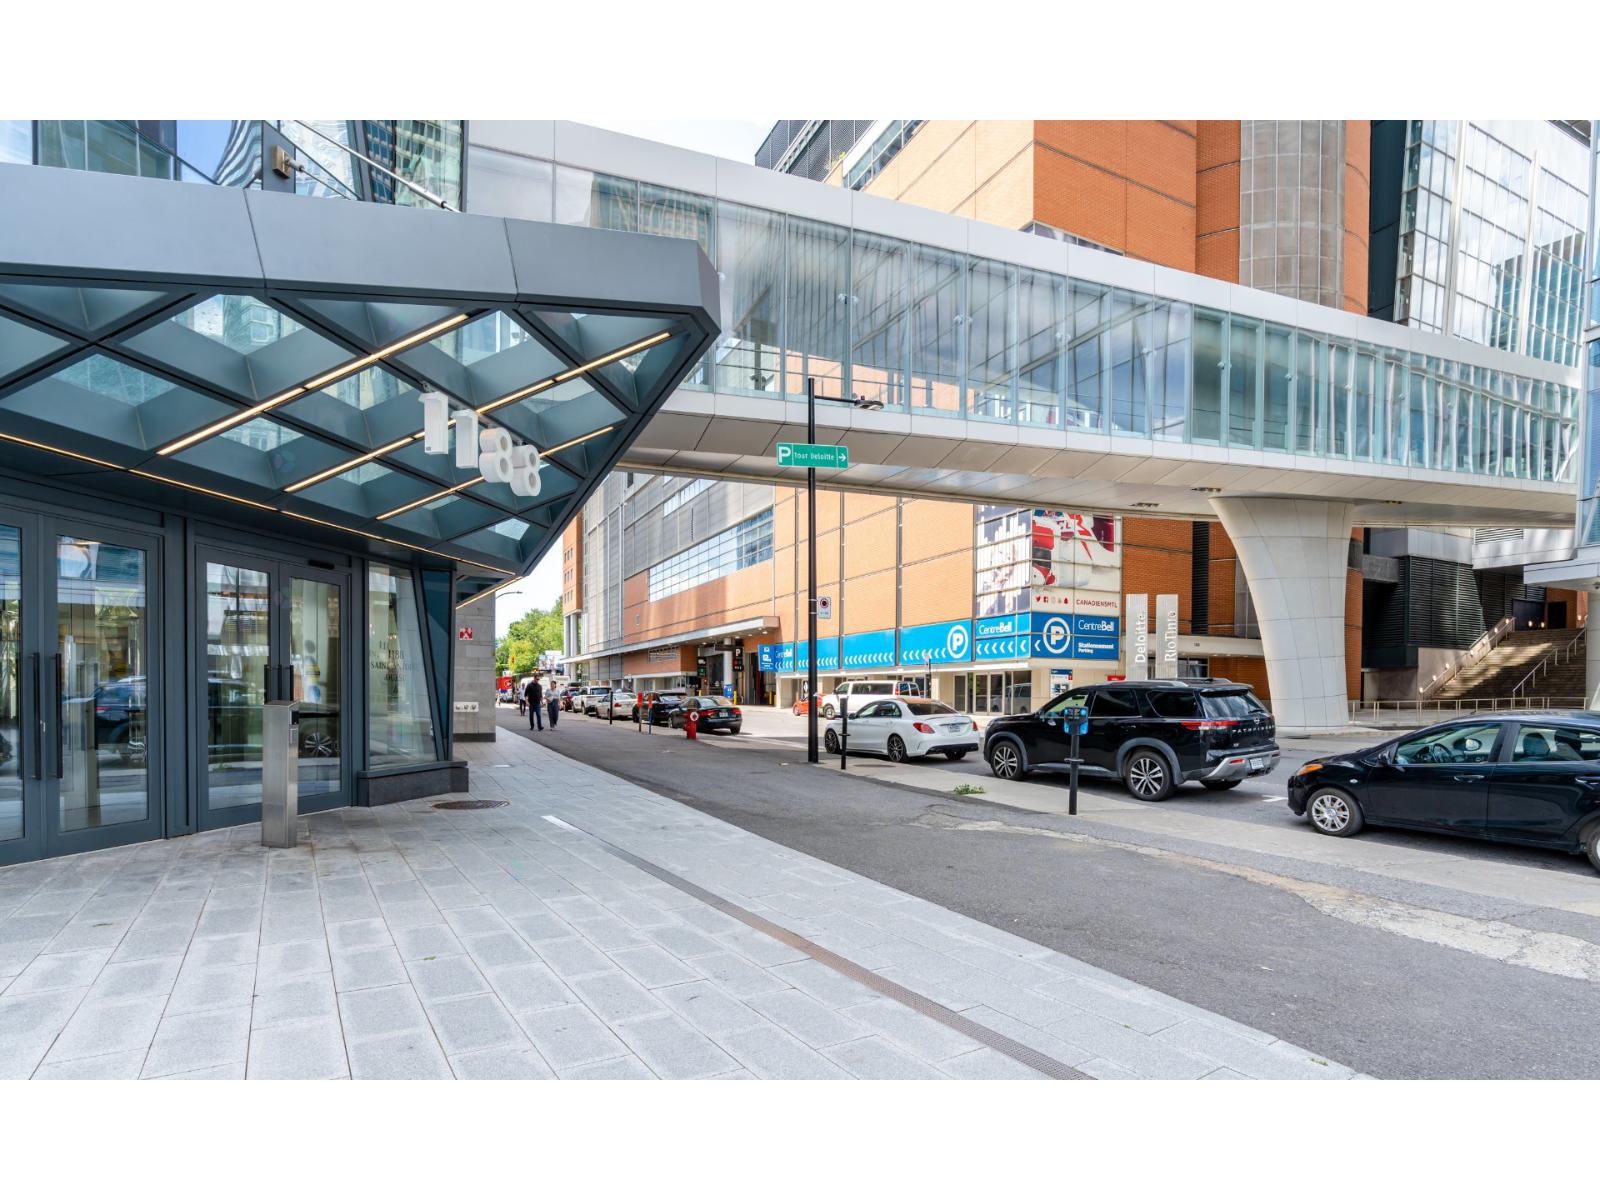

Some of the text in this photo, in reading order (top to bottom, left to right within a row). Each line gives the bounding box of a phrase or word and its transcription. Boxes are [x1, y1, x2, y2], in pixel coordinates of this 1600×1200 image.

[418, 391, 542, 497] 1188
[778, 446, 791, 463] P
[810, 453, 834, 461] Deloitte
[1076, 599, 1118, 608] CANADIENSMTL
[1078, 642, 1114, 650] Stationnement
[1135, 613, 1146, 663] Deloitte
